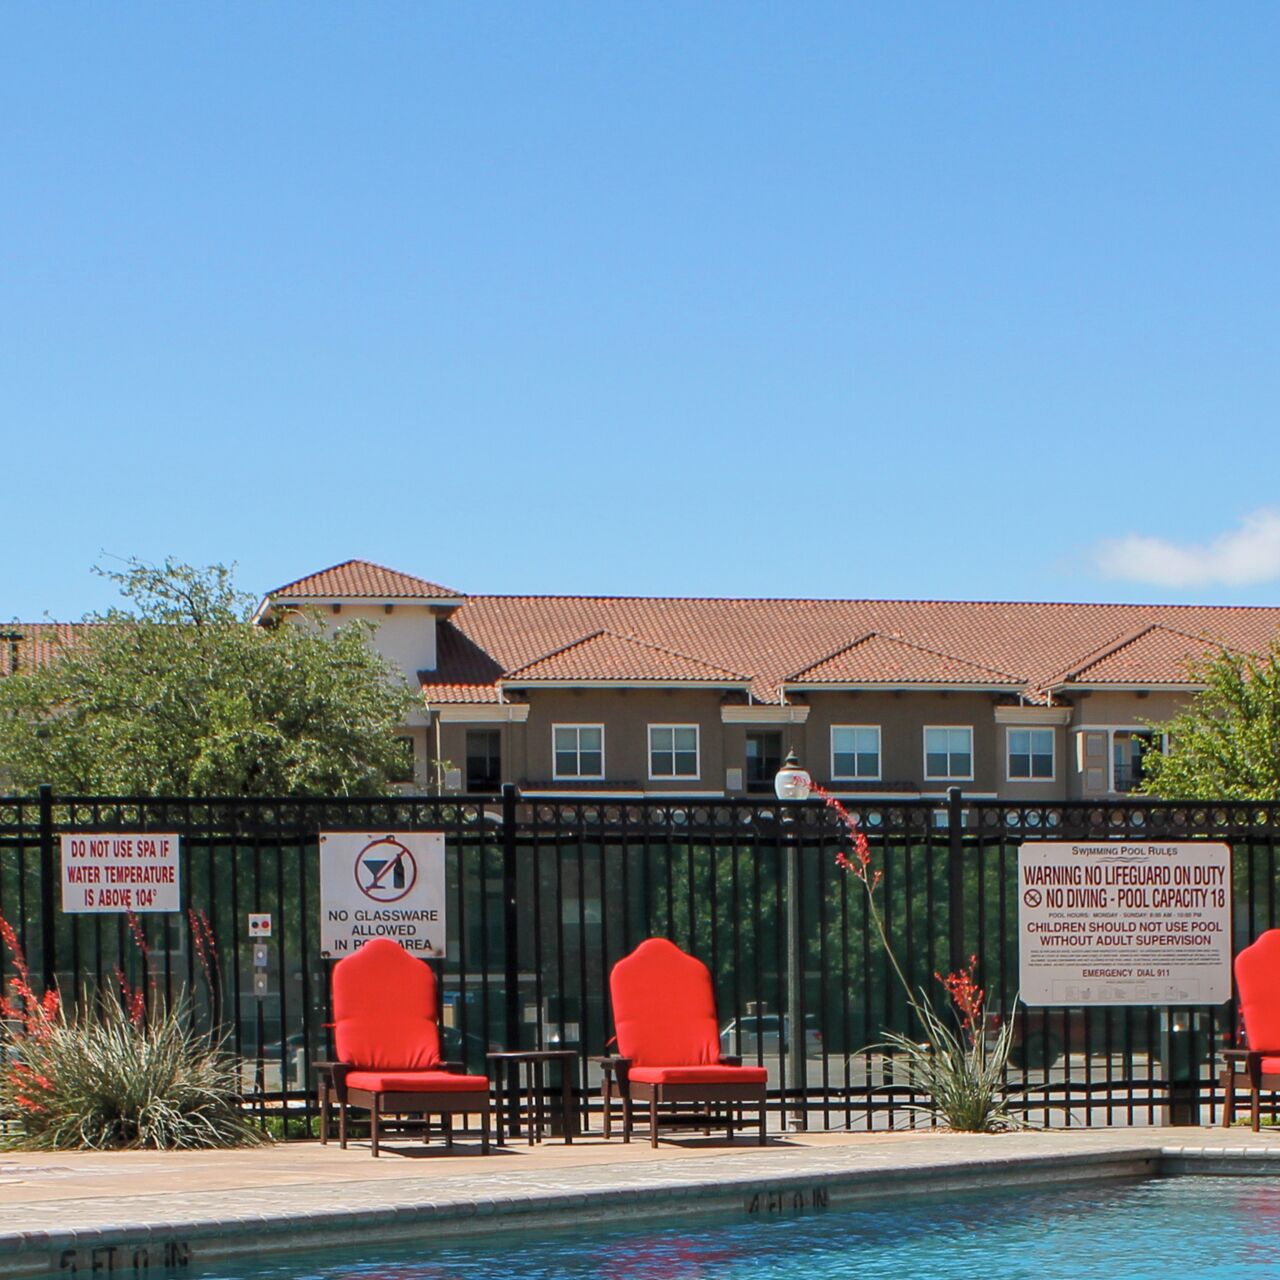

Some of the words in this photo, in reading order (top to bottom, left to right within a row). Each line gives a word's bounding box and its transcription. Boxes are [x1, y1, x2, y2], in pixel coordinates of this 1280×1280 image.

[71, 840, 86, 858] DO
[90, 840, 109, 858] NOT
[113, 840, 133, 858] USE
[137, 840, 156, 858] SPA
[160, 840, 169, 858] IF
[67, 866, 100, 884] WATER
[105, 866, 175, 884] TEMPERATURE
[1023, 865, 1081, 885] WARNING
[1085, 865, 1102, 885] NO
[1105, 865, 1171, 885] LIFEGUARD
[1174, 865, 1191, 885] ON
[1194, 865, 1225, 885] DUTY
[84, 889, 94, 907] IS
[98, 889, 131, 907] ABOVE
[136, 889, 157, 907] 104°
[1046, 888, 1063, 908] NO
[1066, 888, 1107, 908] DIVING
[1118, 888, 1149, 908] POOL
[1152, 888, 1208, 908] CAPACITY
[1211, 888, 1225, 908] 18
[328, 911, 349, 922] NO
[354, 910, 438, 922] GLASSWARE
[351, 925, 417, 936] ALLOWED
[1027, 922, 1086, 932] CHILDREN
[1089, 922, 1136, 932] SHOULD
[1139, 921, 1162, 932] NOT
[1165, 921, 1188, 932] USE
[1191, 921, 1223, 932] POOL
[334, 939, 348, 950] IN
[398, 939, 432, 950] AREA
[1040, 935, 1093, 946] WITHOUT
[1096, 935, 1133, 946] ADULT
[1136, 935, 1211, 945] SUPERVISION
[1082, 969, 1133, 977] EMERGENCY
[1137, 969, 1155, 977] DIAL
